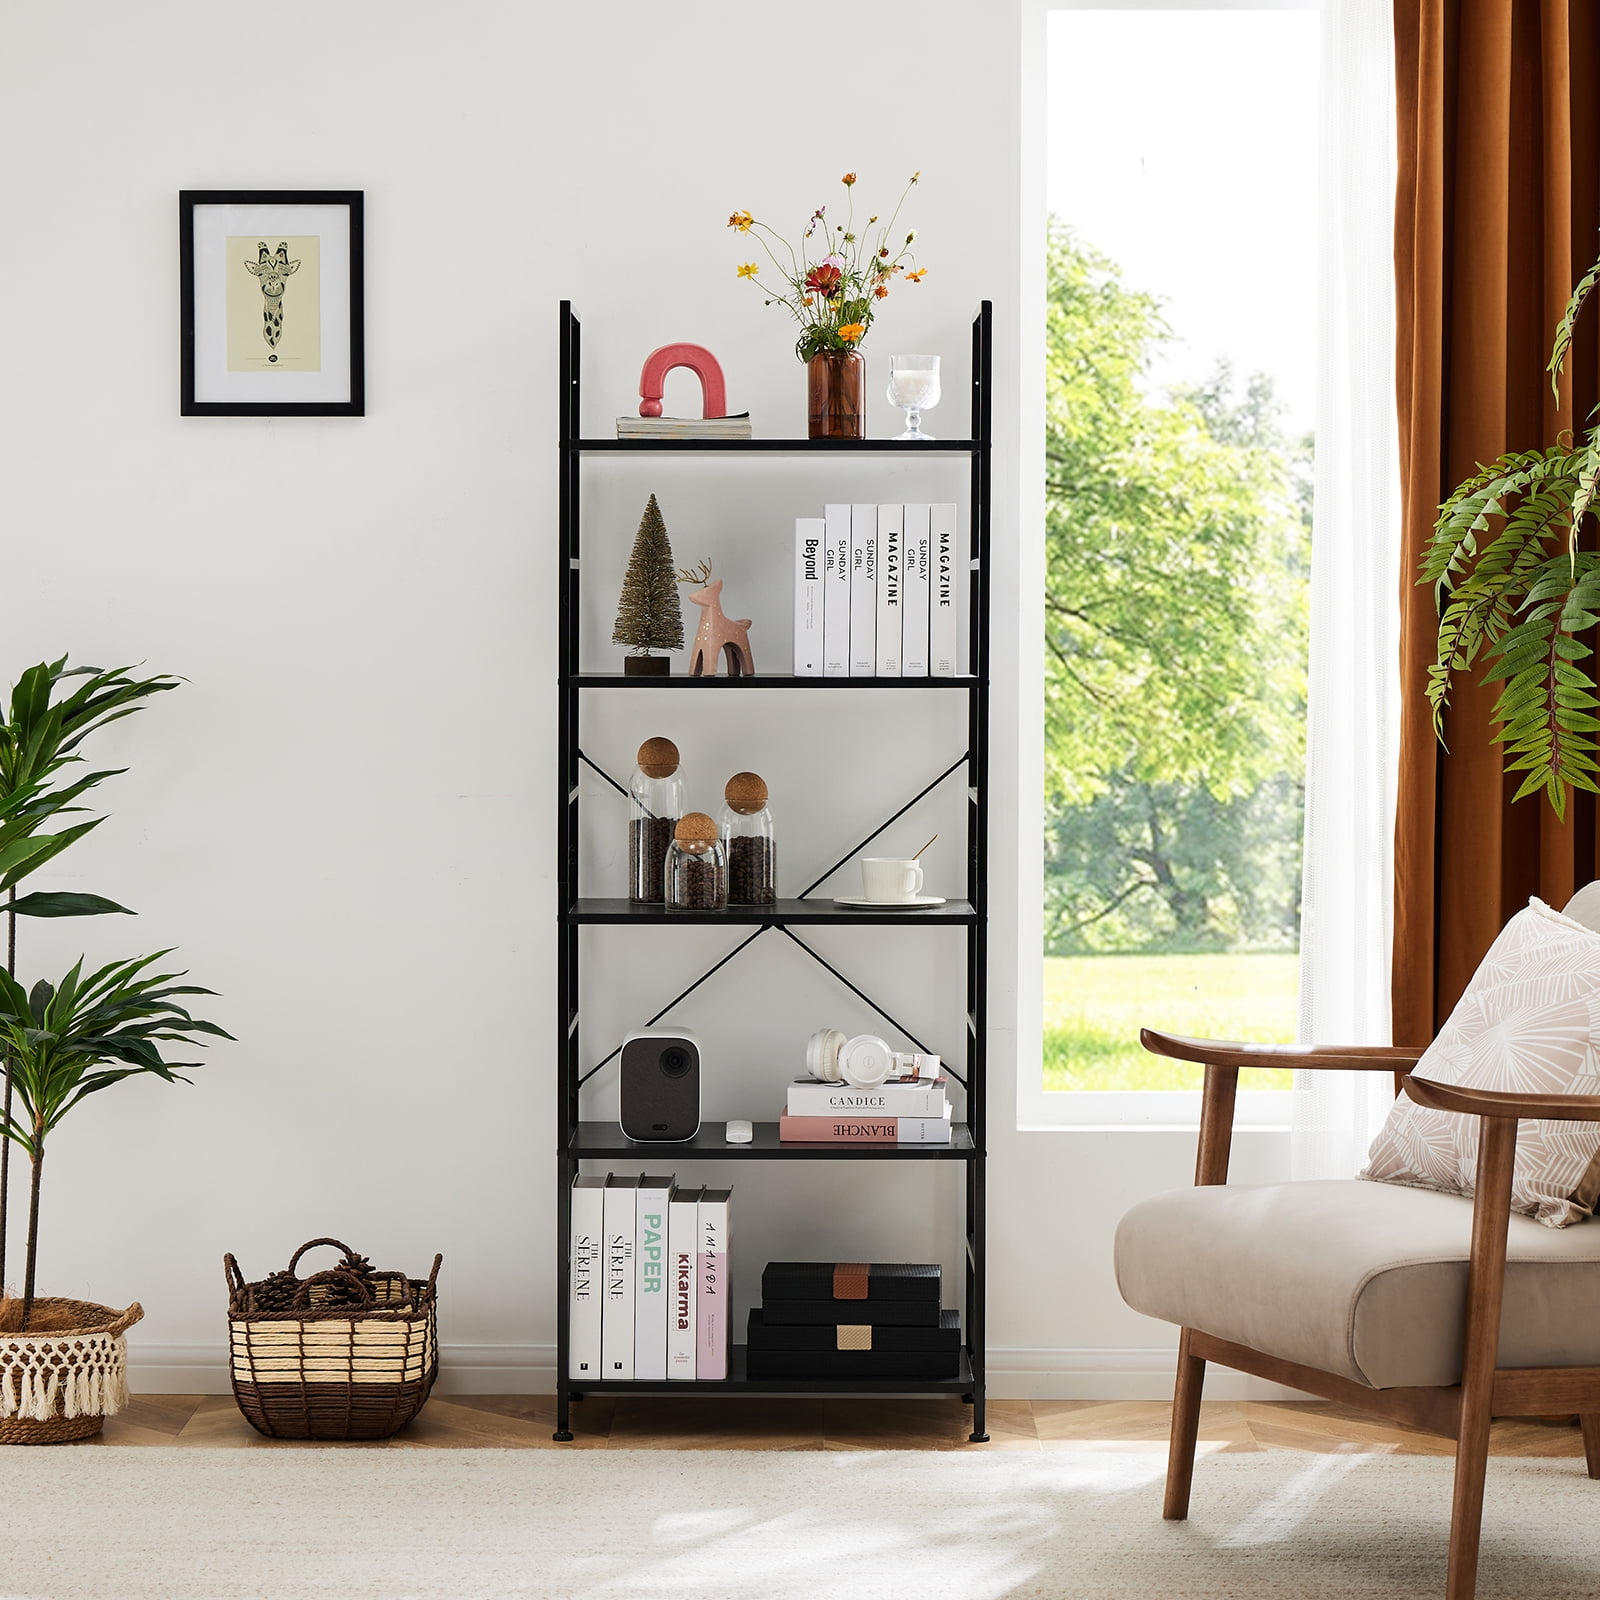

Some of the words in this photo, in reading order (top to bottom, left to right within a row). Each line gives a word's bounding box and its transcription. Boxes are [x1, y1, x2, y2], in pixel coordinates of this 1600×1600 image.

[802, 539, 819, 580] Beyond
[827, 549, 835, 571] GIRL
[838, 539, 847, 581] SUNDAY
[854, 549, 863, 571] GIRL
[866, 539, 875, 580] SUNDAY
[888, 532, 898, 606] MAGAZINE
[907, 549, 915, 571] GIRL
[919, 539, 927, 581] SUNDAY
[940, 533, 950, 607] MAGAZINE
[829, 1096, 886, 1106] CANDICE
[833, 1124, 895, 1137] BLANCHE
[576, 1235, 590, 1301] SERENE
[591, 1242, 599, 1260] THE
[610, 1235, 624, 1300] SERENE
[644, 1214, 661, 1292] PAPER
[706, 1222, 716, 1295] AMANDA
